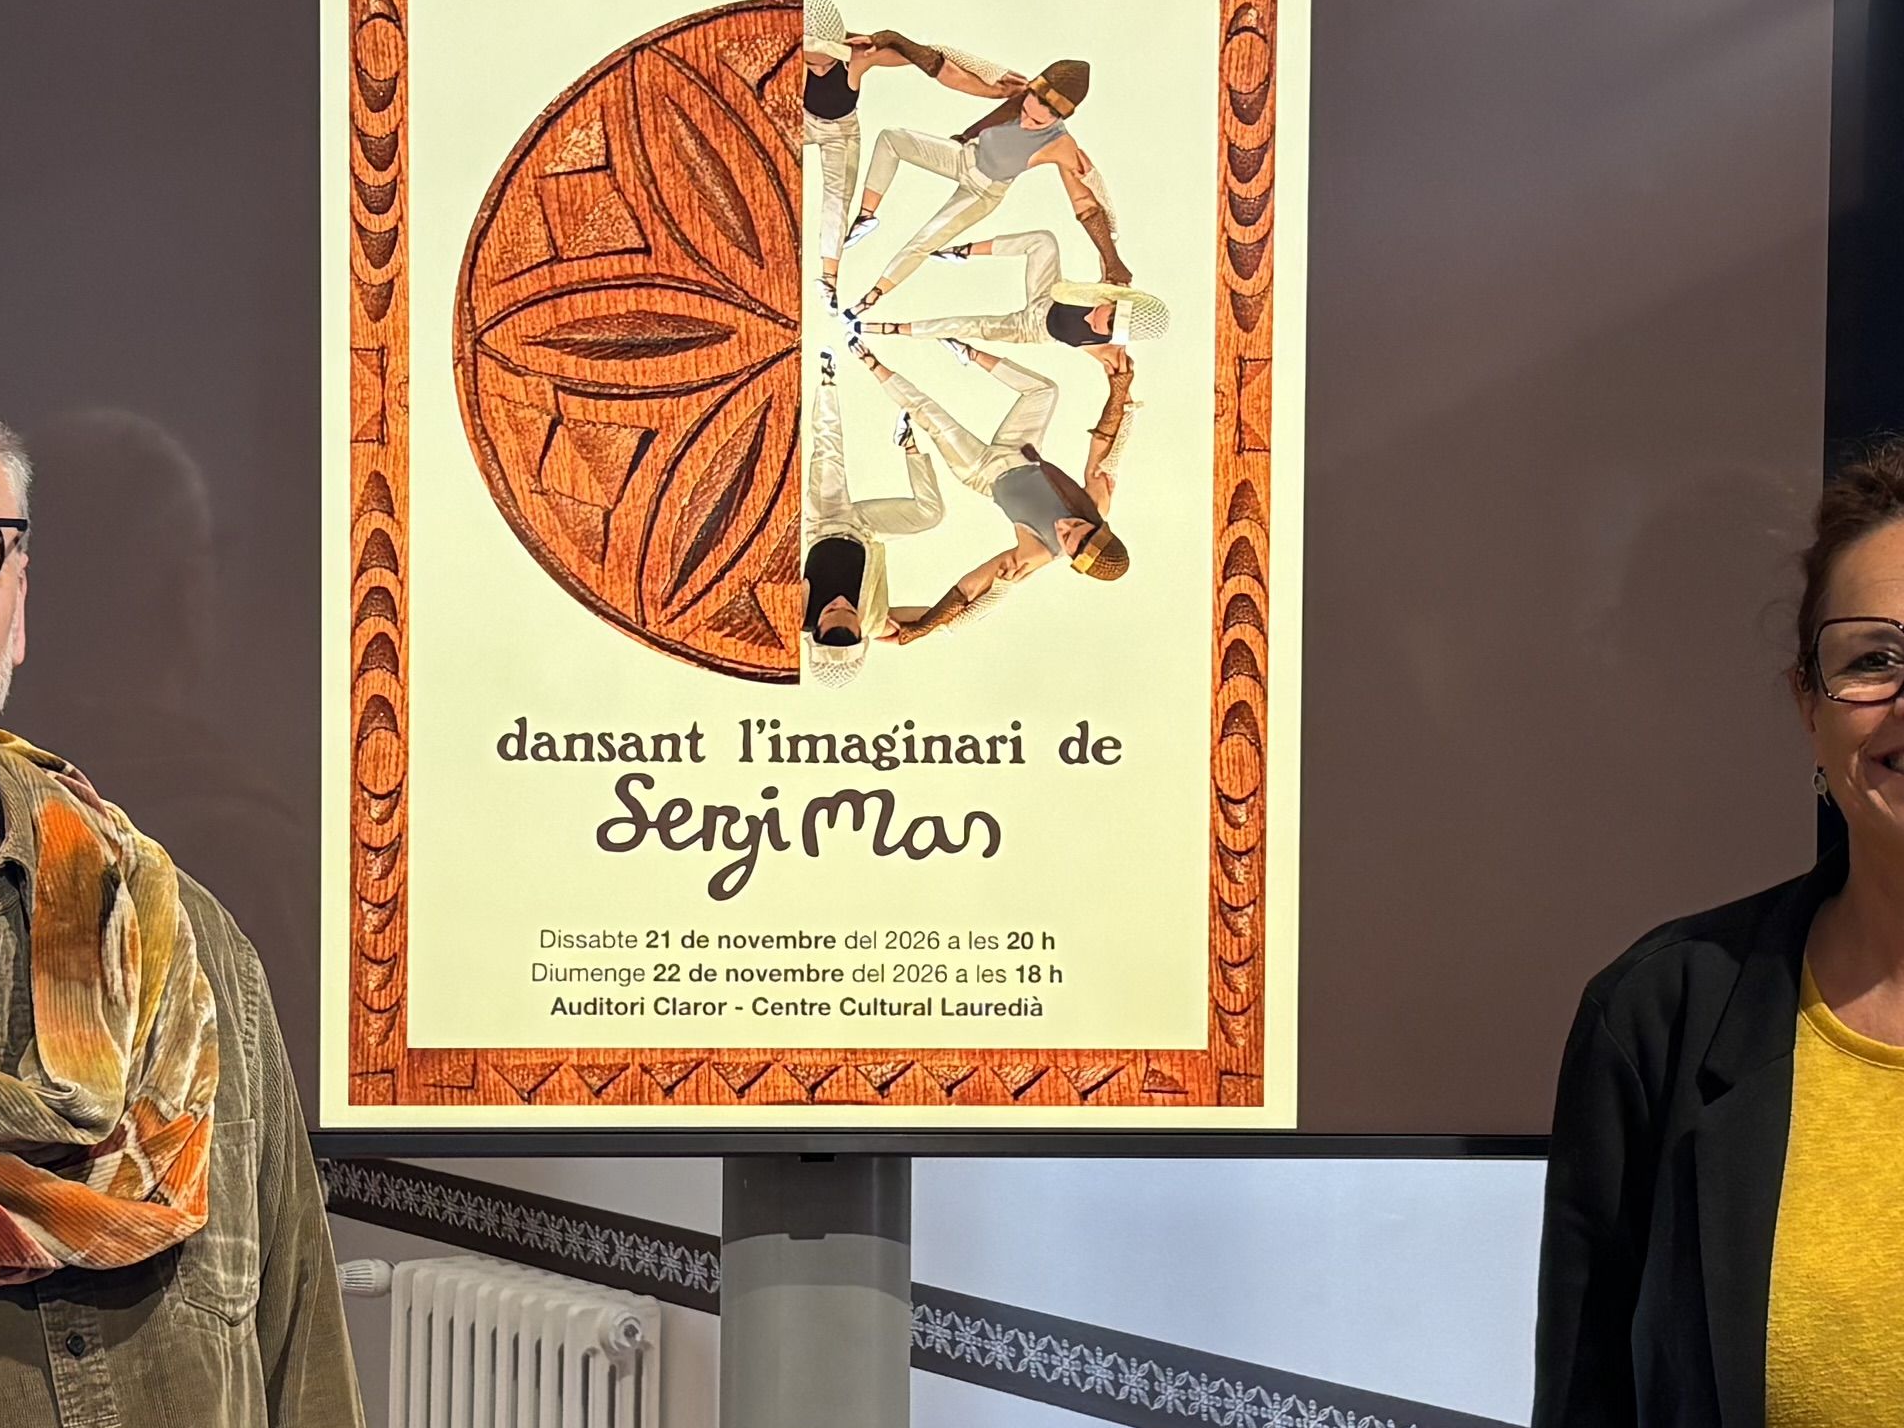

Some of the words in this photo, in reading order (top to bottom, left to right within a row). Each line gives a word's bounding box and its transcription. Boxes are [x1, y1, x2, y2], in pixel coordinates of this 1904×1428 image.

[496, 716, 706, 764] dansant
[738, 718, 1026, 772] l'imaginari
[1058, 720, 1122, 766] de
[596, 772, 792, 902] Sergi
[801, 788, 1002, 861] Mas
[540, 929, 638, 949] Dissabte
[645, 929, 670, 949] 21
[680, 929, 710, 949] de
[717, 929, 837, 950] novembre
[844, 930, 877, 950] del
[884, 930, 940, 950] 2026
[947, 935, 961, 950] a
[968, 930, 999, 950] les
[1006, 931, 1034, 950] 20
[1041, 931, 1055, 951] h
[531, 962, 646, 988] Diumenge
[652, 963, 681, 983] 22
[688, 962, 718, 983] de
[725, 963, 845, 983] novembre
[852, 963, 885, 983] del
[892, 963, 948, 984] 2026
[955, 968, 969, 984] a
[976, 964, 1007, 984] les
[1015, 964, 1042, 984] 18
[1049, 964, 1063, 984] h
[550, 996, 645, 1016] Auditori
[653, 996, 728, 1016] Claror
[751, 996, 832, 1017] Centre
[839, 996, 932, 1017] Cultural
[941, 995, 1043, 1017] Lauredià
